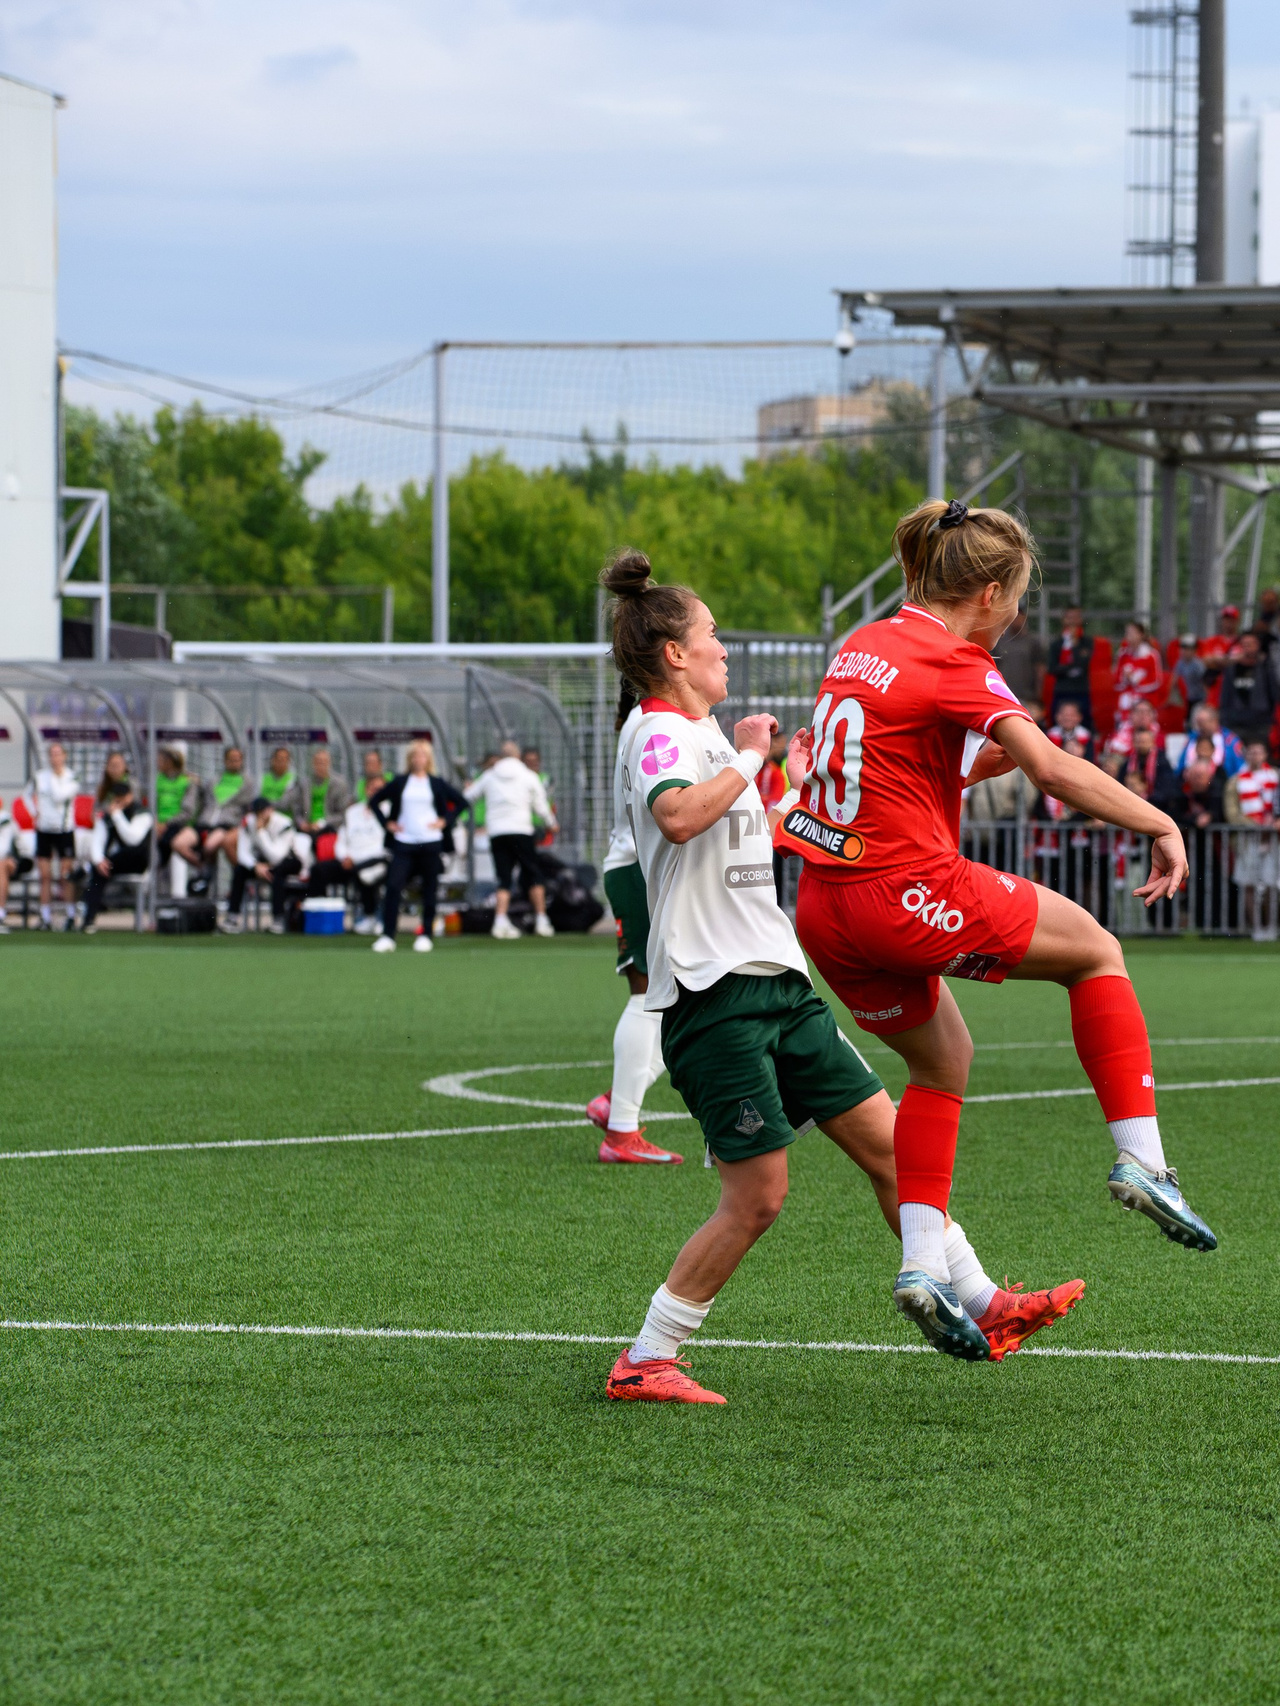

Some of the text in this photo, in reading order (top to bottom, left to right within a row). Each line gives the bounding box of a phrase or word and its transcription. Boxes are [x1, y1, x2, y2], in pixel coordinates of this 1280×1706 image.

[803, 692, 865, 826] 10
[788, 812, 845, 852] WINLINE
[852, 1004, 904, 1021] ENESIS
